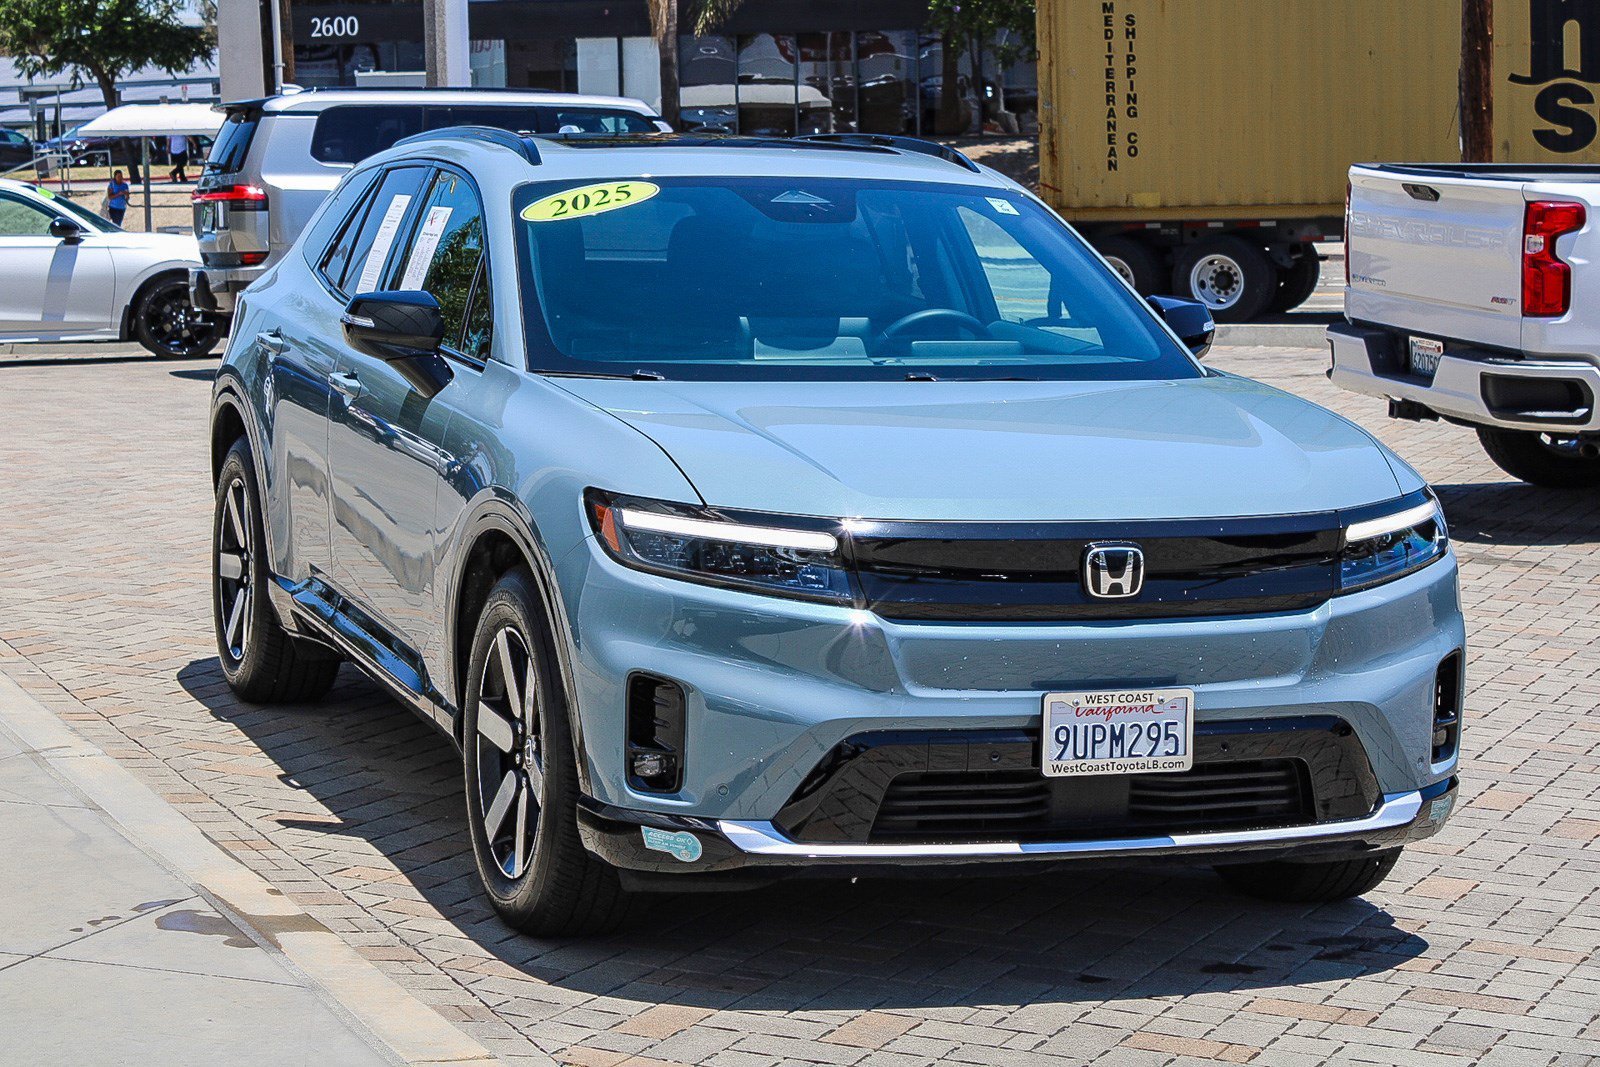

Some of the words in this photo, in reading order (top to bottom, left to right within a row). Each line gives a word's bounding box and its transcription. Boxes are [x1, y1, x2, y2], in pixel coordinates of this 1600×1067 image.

[310, 16, 359, 38] 2600
[1125, 14, 1138, 118] SHIPPING
[1102, 2, 1118, 171] MEDITERRANEAN
[1127, 132, 1138, 157] CO
[550, 184, 632, 218] 2025
[1085, 693, 1117, 705] WEST
[1118, 692, 1154, 704] COAST
[1054, 721, 1179, 761] 9UPM295
[1051, 759, 1185, 774] WestCoastToyotaLB.com
